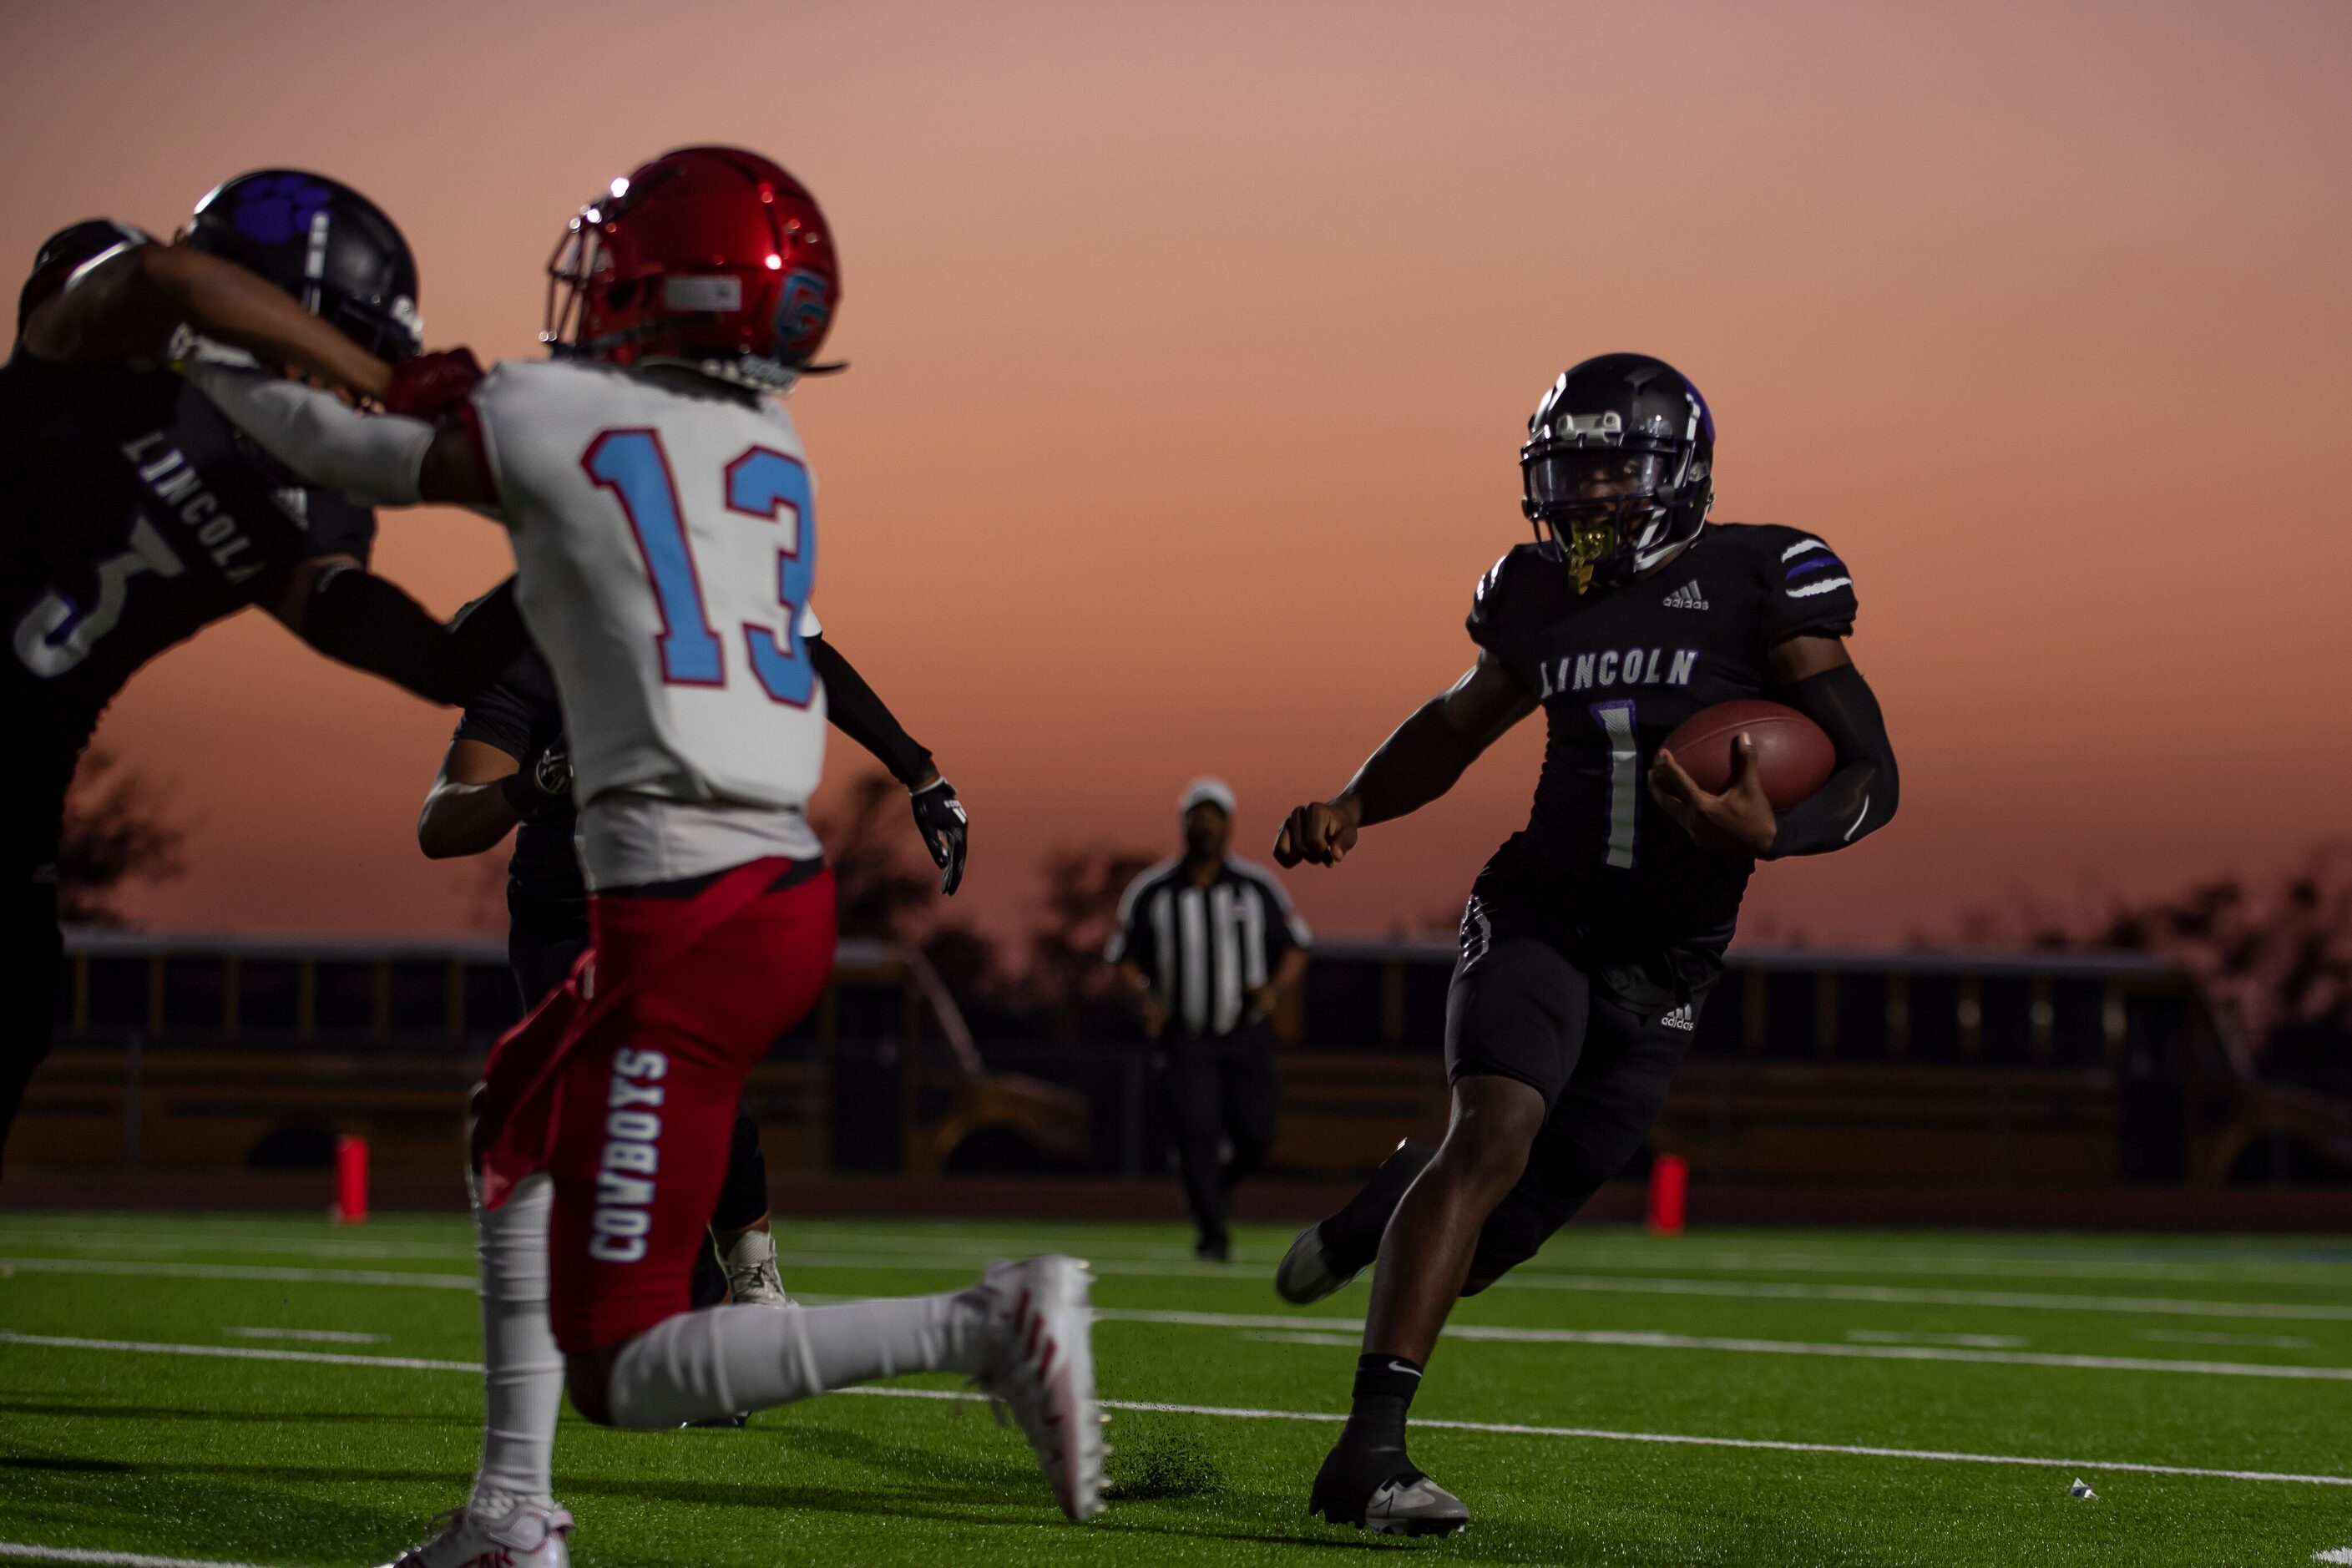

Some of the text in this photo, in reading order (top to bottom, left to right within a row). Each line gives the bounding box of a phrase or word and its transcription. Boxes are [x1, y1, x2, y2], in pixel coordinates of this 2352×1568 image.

[12, 506, 187, 680] 3
[581, 427, 817, 710] 13
[1662, 595, 1710, 610] adidas
[1539, 646, 1699, 700] LINCOLN
[1590, 699, 1639, 870] 1
[1661, 1015, 1695, 1031] adidas
[586, 1046, 669, 1263] COWBOYS
